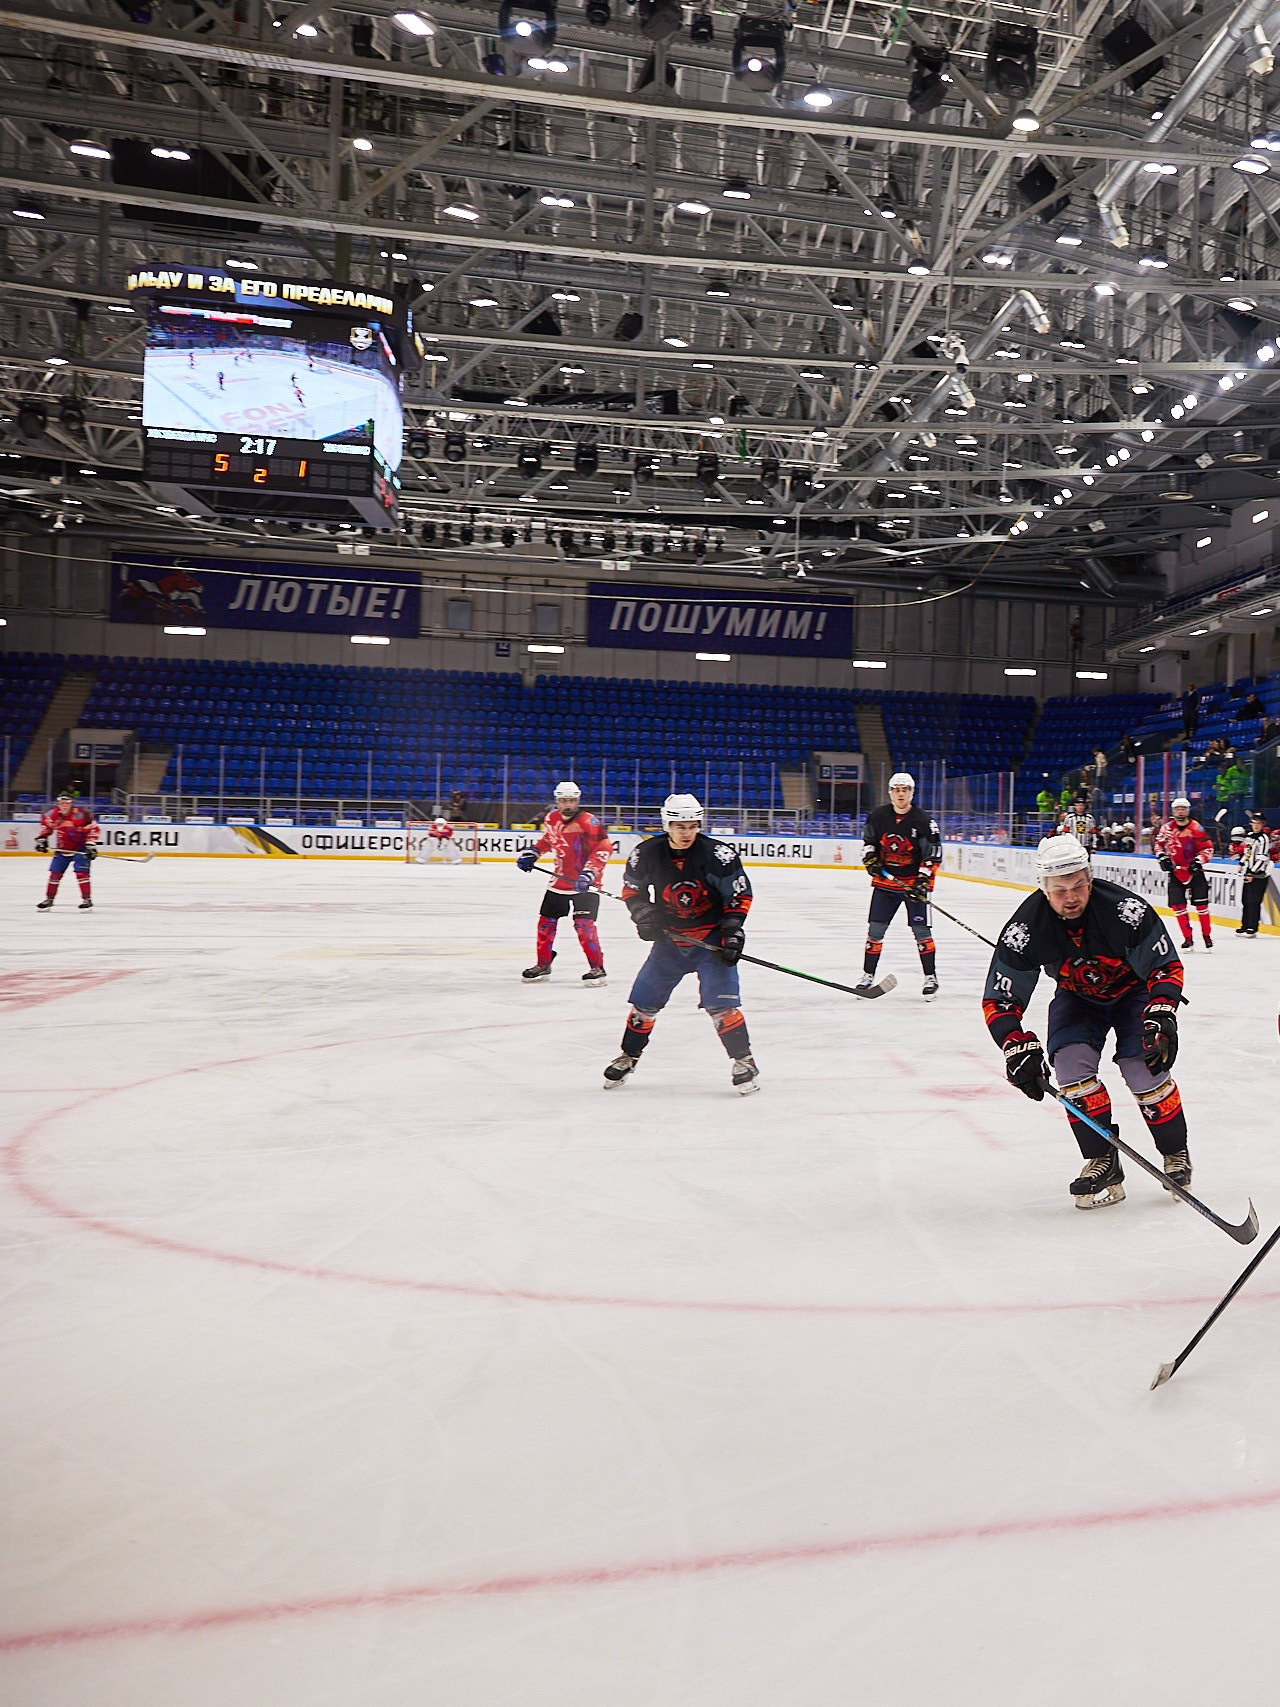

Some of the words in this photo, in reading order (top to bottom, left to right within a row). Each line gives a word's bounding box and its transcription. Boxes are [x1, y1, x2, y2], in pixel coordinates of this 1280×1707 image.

[187, 273, 204, 290] И
[208, 275, 236, 294] ЗА
[241, 279, 277, 298] ЕГО
[282, 283, 393, 315] ПРЕДЕЛАМИ
[214, 453, 231, 472] 5
[298, 460, 308, 478] 1
[253, 468, 268, 484] 2
[228, 579, 407, 620] ЛЮТЫЕ!
[609, 601, 828, 641] ПОШУМИМ!
[95, 830, 179, 847] IGA.RU
